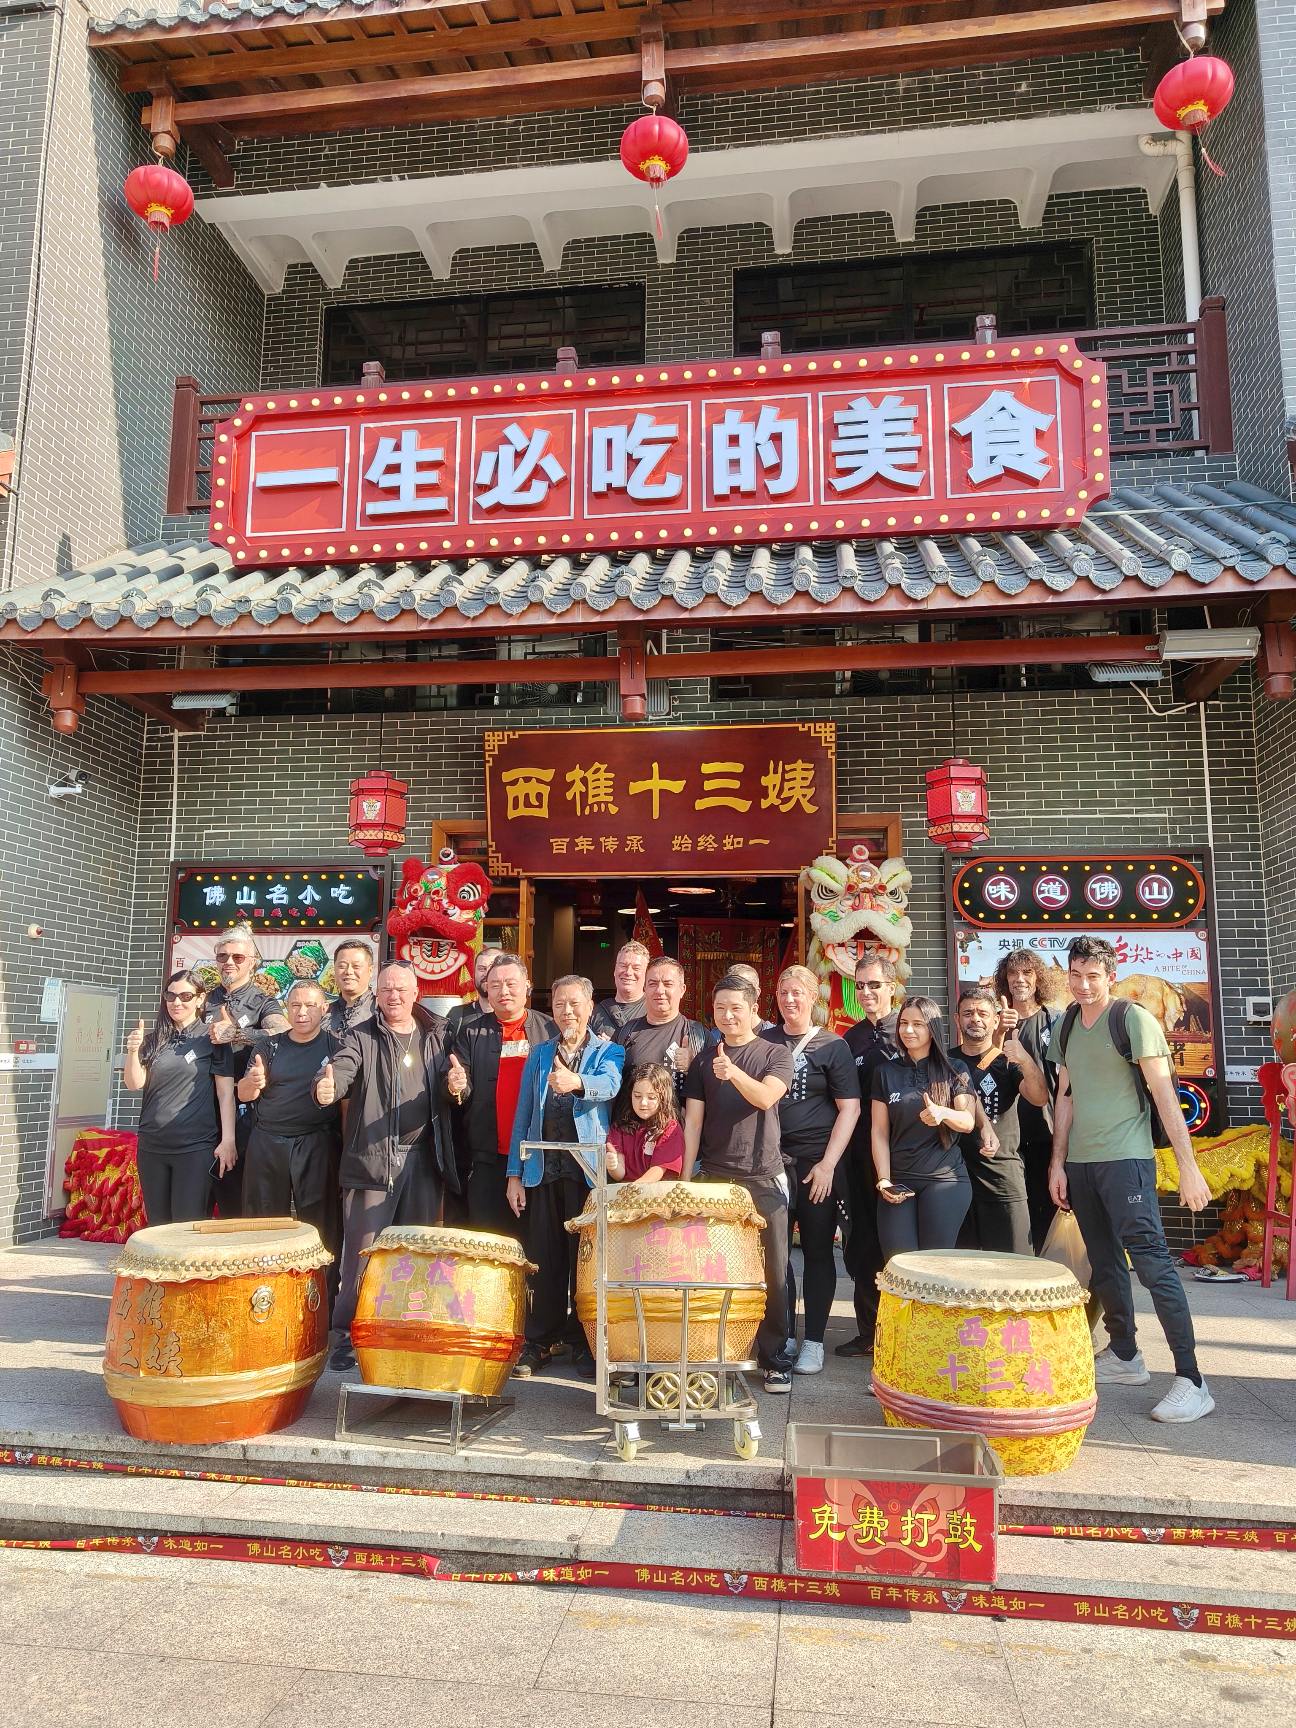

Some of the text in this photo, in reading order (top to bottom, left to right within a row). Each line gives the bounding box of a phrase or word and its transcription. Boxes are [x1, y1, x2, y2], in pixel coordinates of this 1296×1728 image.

[253, 387, 1058, 518] 一生必吃的美食
[501, 759, 820, 820] 西樵十三姨
[549, 834, 771, 854] 百年传承 始终如一
[202, 883, 355, 906] 佛山名小吃
[988, 880, 1169, 901] 味道佛山
[1028, 937, 1067, 949] CCTV
[937, 1353, 1056, 1396] 十三姨
[808, 1503, 983, 1553] 免费打鼓
[1171, 1527, 1260, 1544] 西樵十三姨
[163, 1538, 224, 1552] 味道如一
[247, 1541, 325, 1562] 佛山名小吃
[353, 1551, 431, 1573] 西樵十三姨
[542, 1566, 610, 1582] 味道如一
[635, 1567, 721, 1588] 佛山名小吃
[753, 1577, 842, 1598] 西樵十三姨
[867, 1585, 940, 1606] 百年传承
[971, 1594, 1046, 1612] 味道如一
[1073, 1601, 1169, 1623] 佛山名小吃
